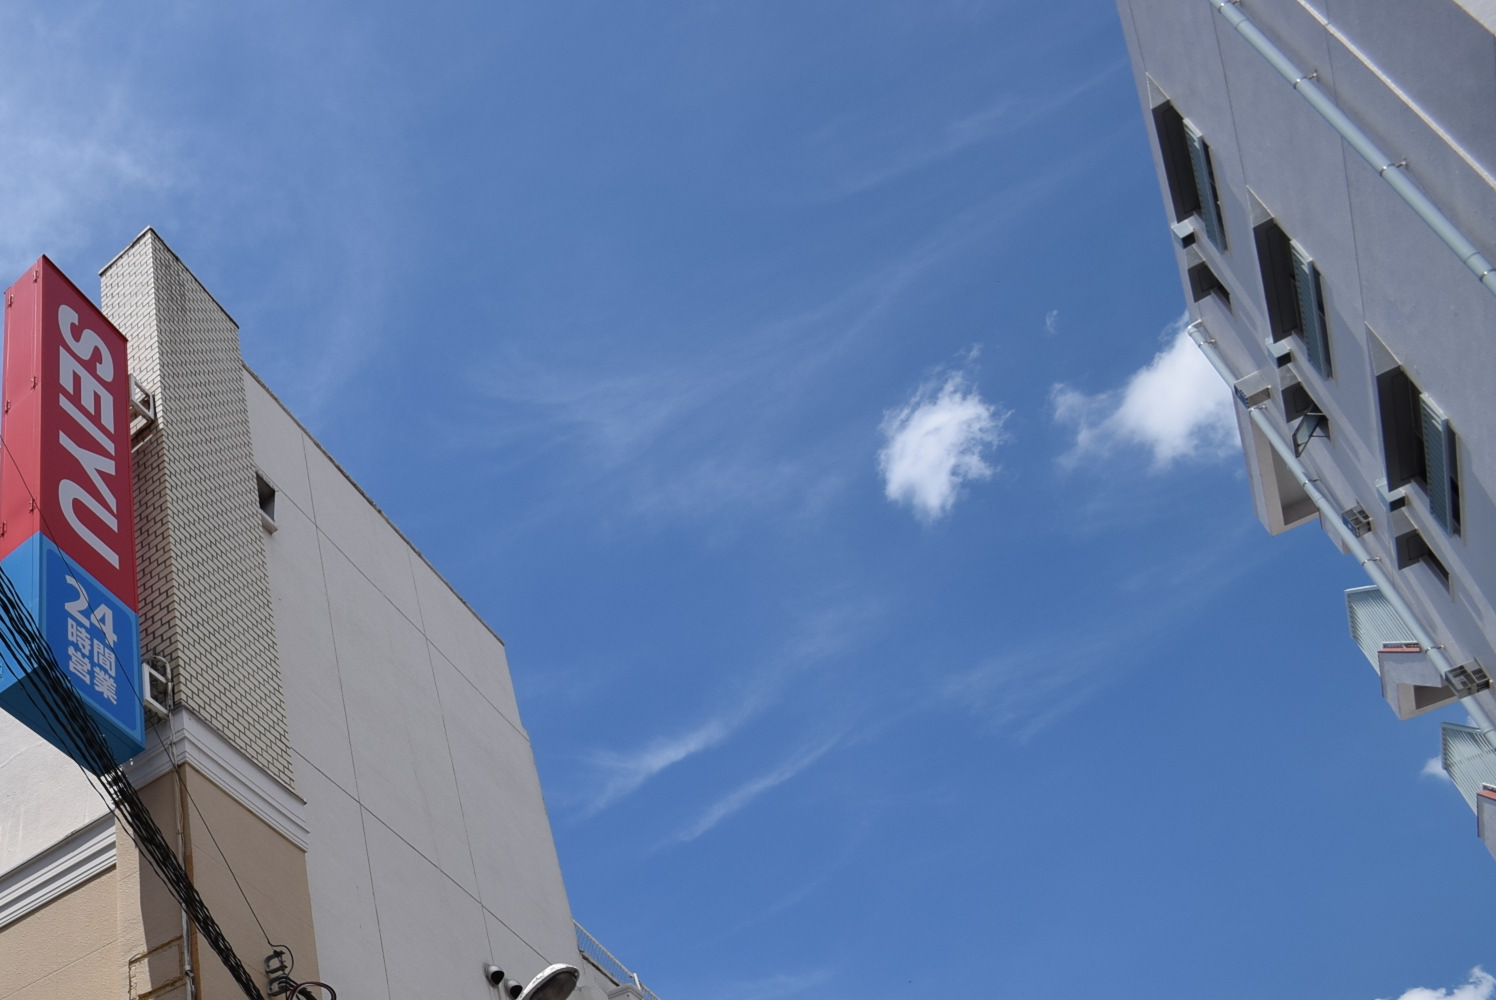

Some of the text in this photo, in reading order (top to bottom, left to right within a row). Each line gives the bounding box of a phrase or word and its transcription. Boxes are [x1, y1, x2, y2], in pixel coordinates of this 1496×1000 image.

[58, 304, 120, 570] SEIYU
[64, 575, 117, 645] 24
[68, 616, 116, 678] 時間
[68, 648, 117, 705] 営業
